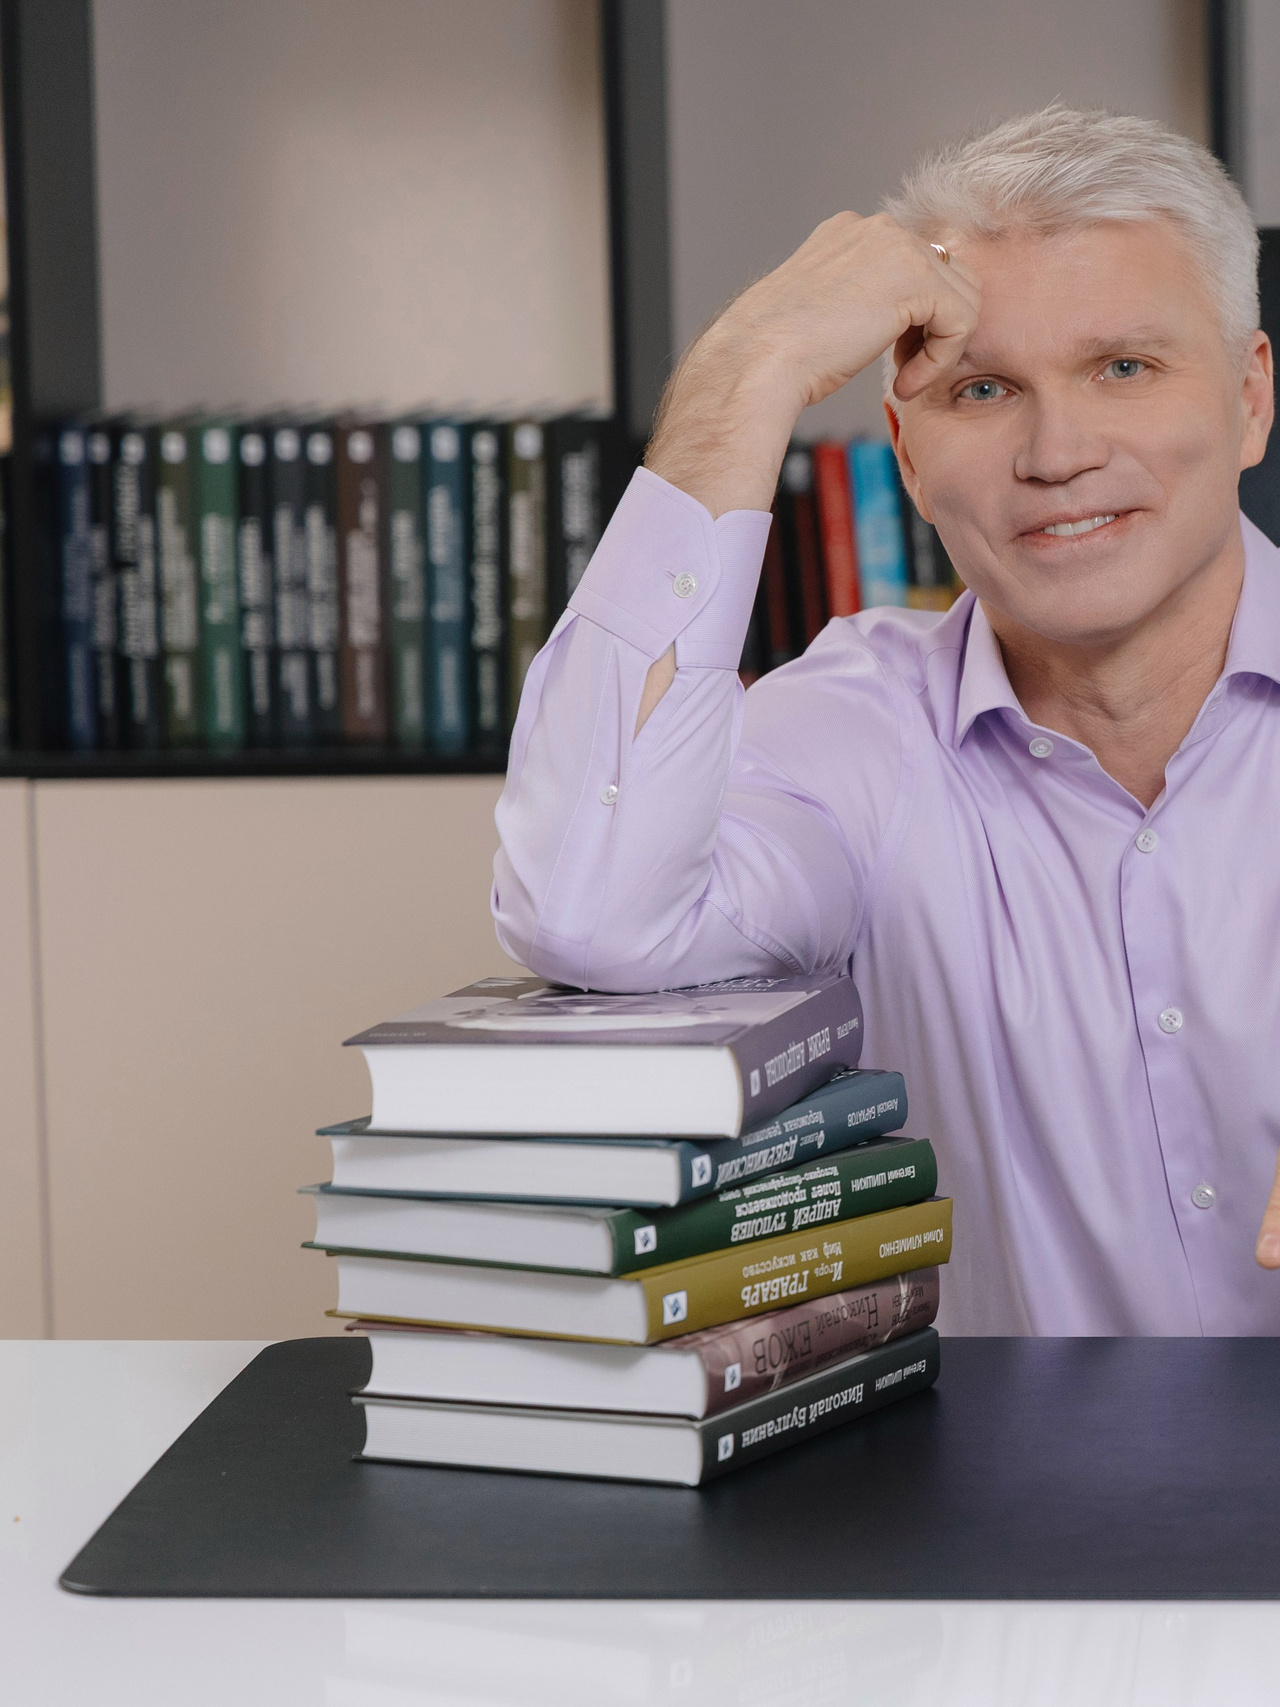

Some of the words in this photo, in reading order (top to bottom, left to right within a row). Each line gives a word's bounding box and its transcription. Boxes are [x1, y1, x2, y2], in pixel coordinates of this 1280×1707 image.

[806, 1027, 831, 1063] ВРЕМЯ
[847, 1105, 877, 1128] БАРХАТОВ
[876, 1098, 899, 1117] Алексей
[783, 1109, 826, 1133] Иеромонах
[799, 1130, 826, 1149] Феликс
[714, 1134, 799, 1190] ДЗЕРЖИНСКИЙ
[851, 1171, 887, 1193] ШИШКИН
[886, 1165, 916, 1184] Евгений
[734, 1185, 807, 1218] продолжается
[811, 1181, 842, 1199] Полет
[730, 1210, 787, 1243] ТУПОЛЕВ
[792, 1199, 842, 1231] АНДРЕЙ
[879, 1234, 923, 1258] КЛИМЕНКО
[923, 1228, 944, 1245] Юлия
[800, 1247, 819, 1263] как
[822, 1241, 843, 1258] Миф
[742, 1252, 796, 1278] искусство
[813, 1261, 844, 1282] Игорь
[740, 1269, 810, 1309] ГРАБАРЬ
[814, 1293, 880, 1337] Николай
[752, 1319, 813, 1375] ЕЖОВ
[874, 1370, 903, 1393] ШИШКИН
[903, 1359, 927, 1381] Евгений
[808, 1383, 865, 1423] Николай
[741, 1405, 807, 1449] Булганин
